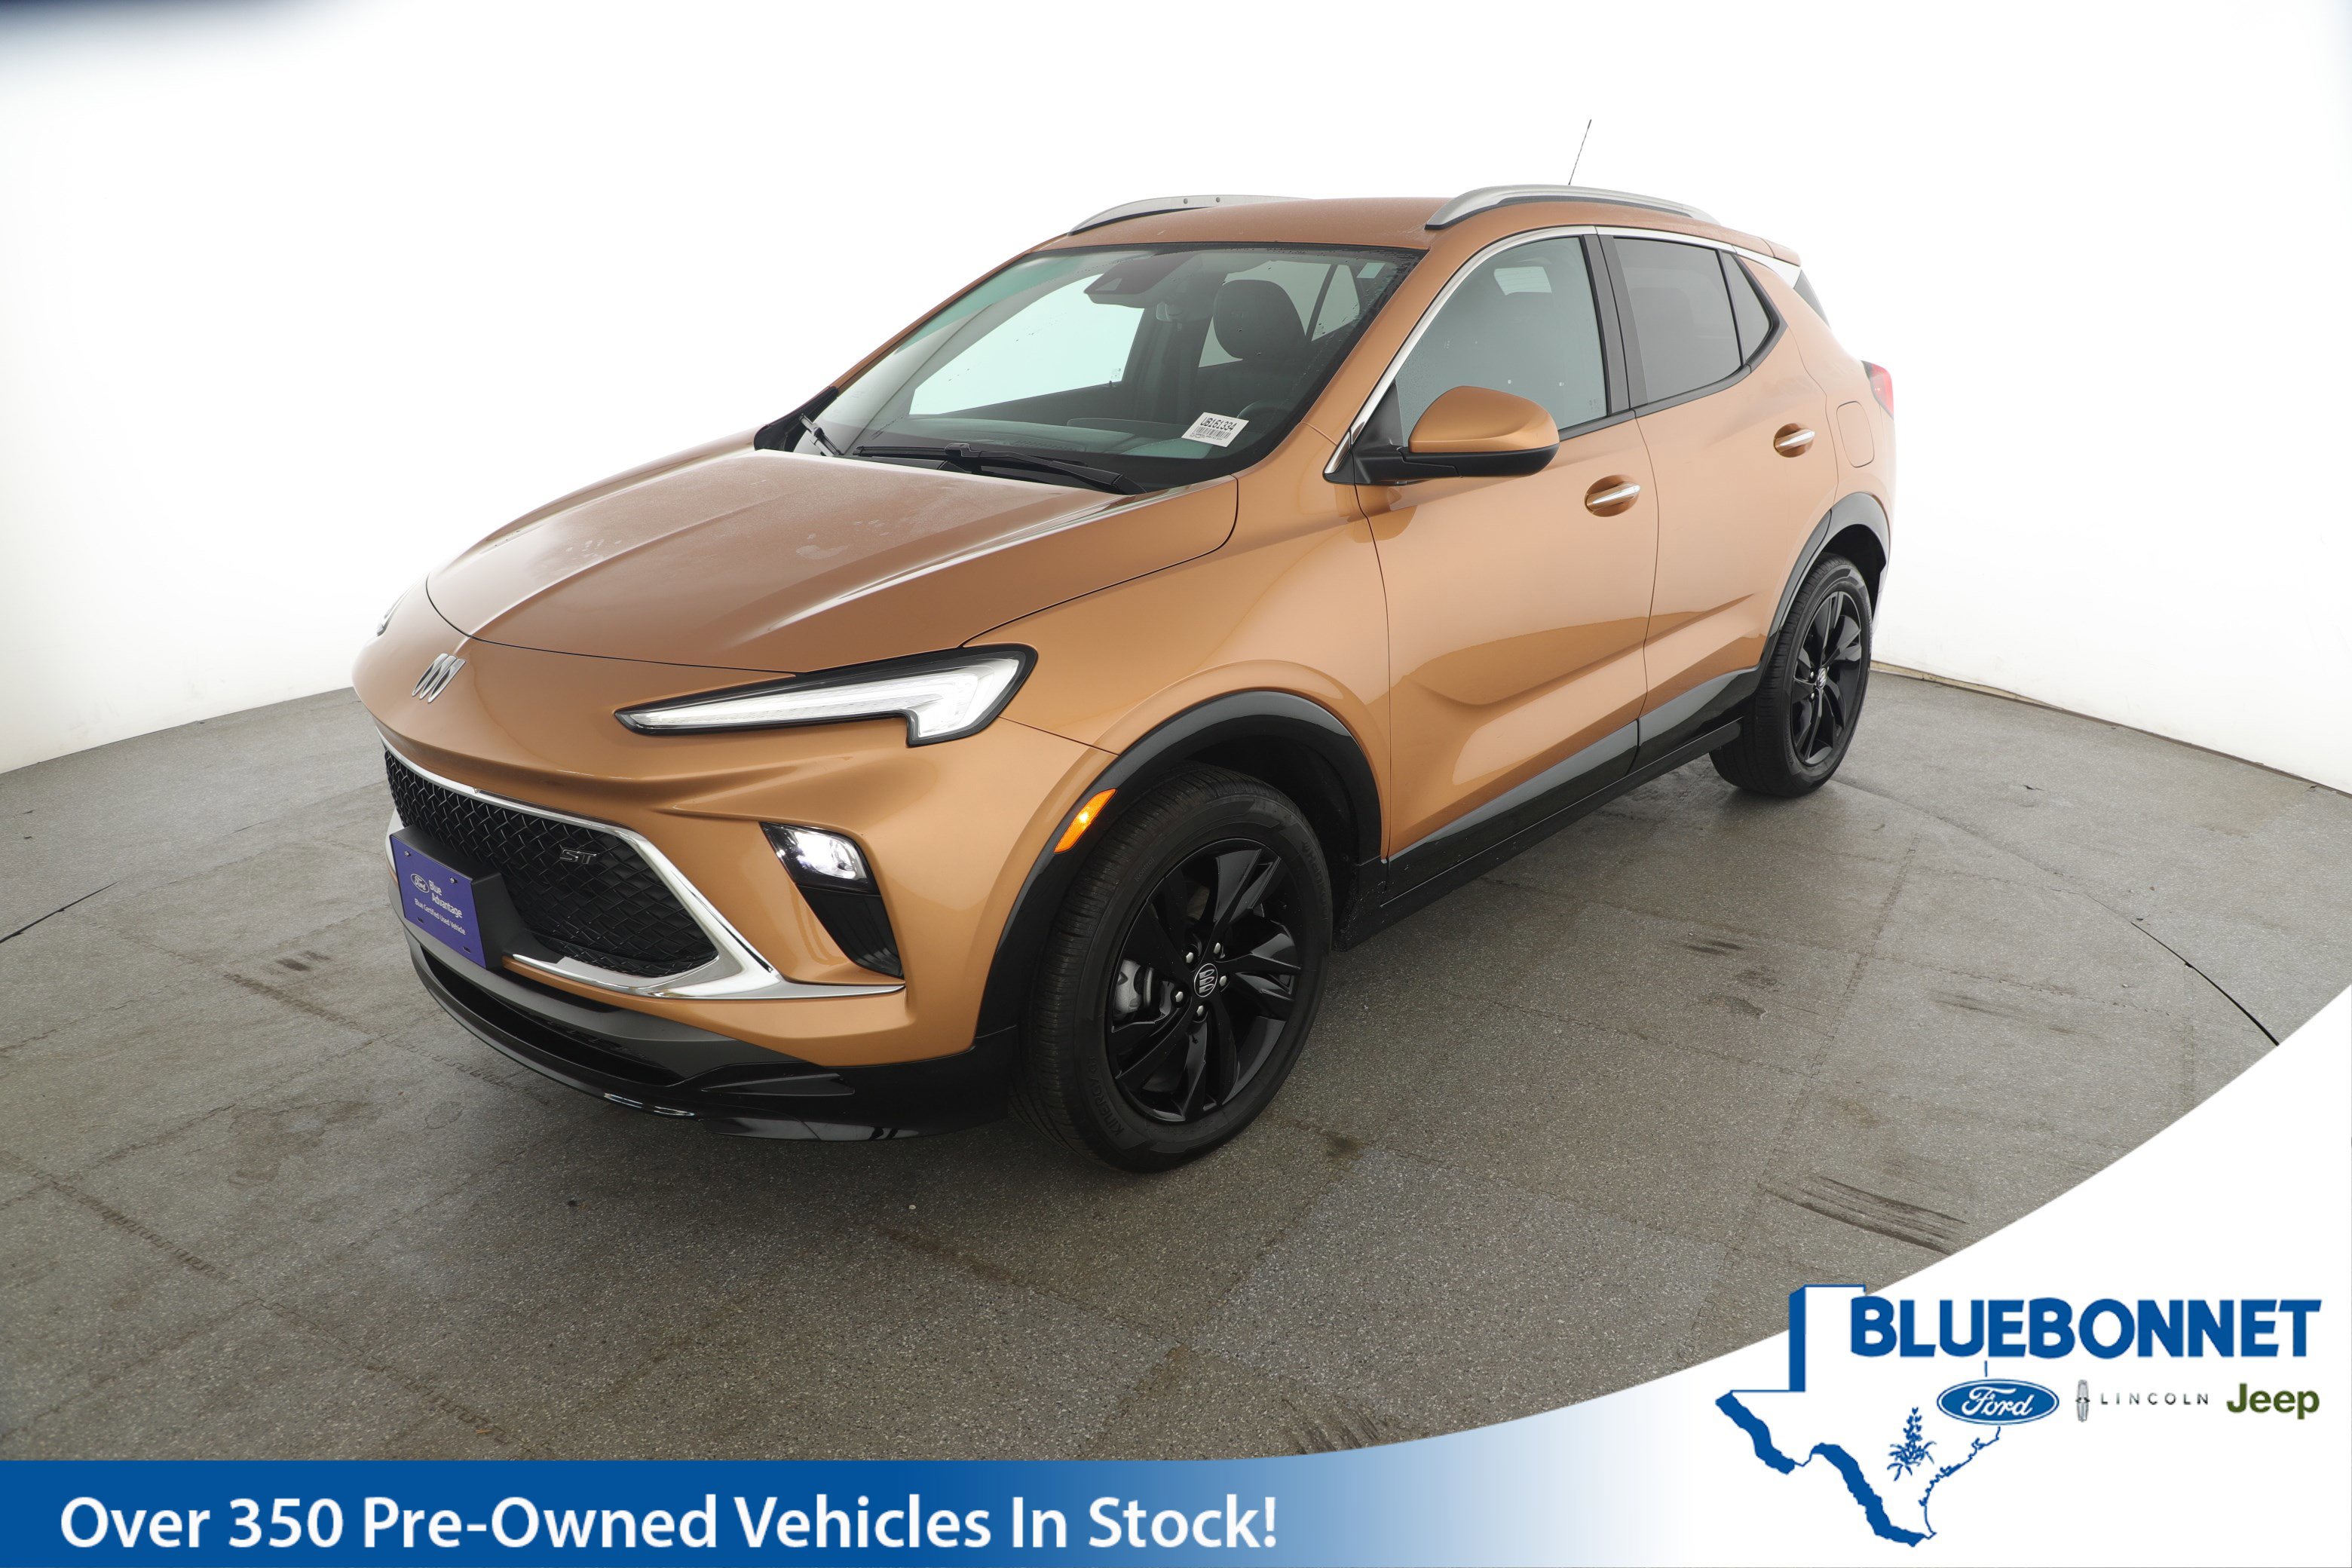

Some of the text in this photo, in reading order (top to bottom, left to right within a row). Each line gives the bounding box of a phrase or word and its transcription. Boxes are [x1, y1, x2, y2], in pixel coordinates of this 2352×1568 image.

[1200, 418, 1236, 431] UB161334
[560, 849, 597, 865] ST
[428, 880, 442, 896] Blue
[431, 893, 462, 917] Advantage
[414, 898, 465, 935] Blue Certified Used Vehicle
